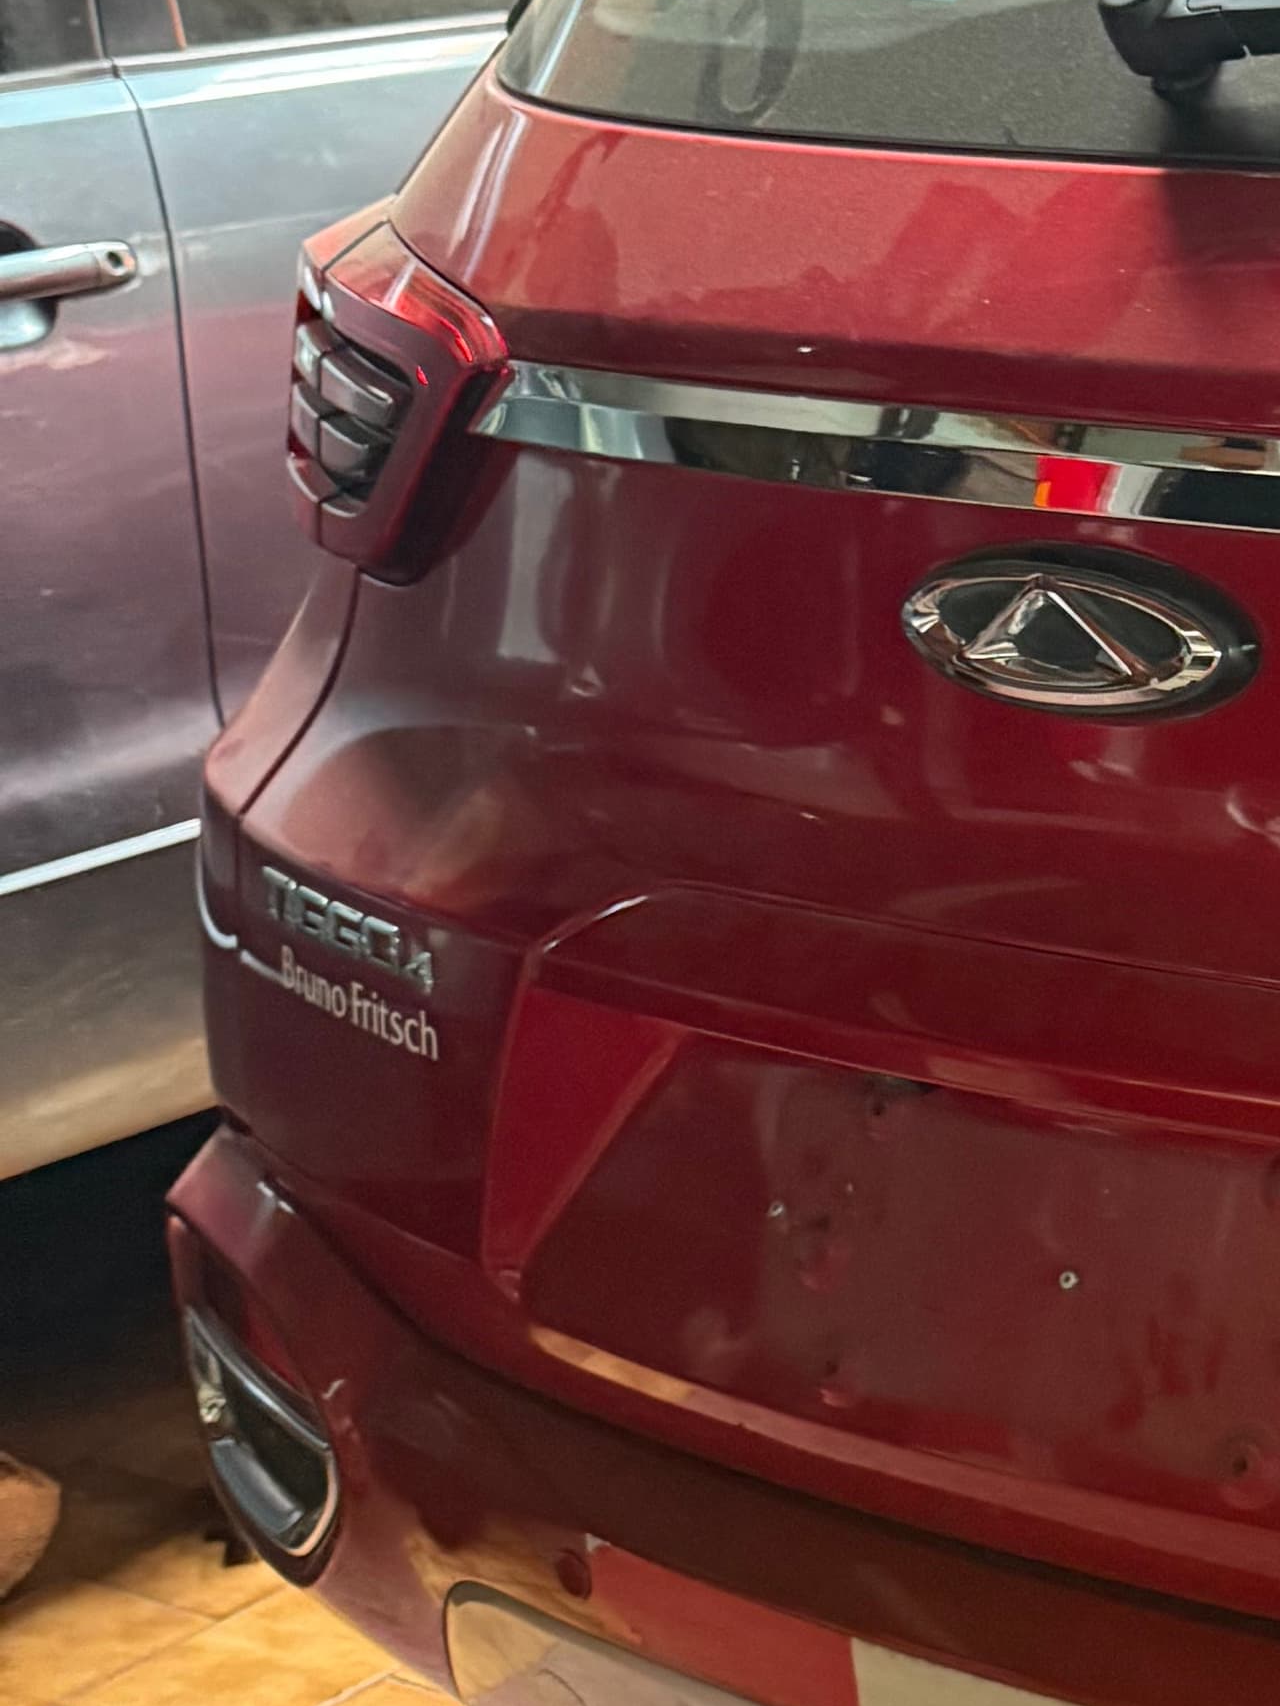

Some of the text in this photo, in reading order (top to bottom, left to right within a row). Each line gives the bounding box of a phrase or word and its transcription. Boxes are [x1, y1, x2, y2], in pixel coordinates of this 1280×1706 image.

[261, 864, 401, 975] TIGGO
[281, 944, 439, 1062] Bruno Fritsch
